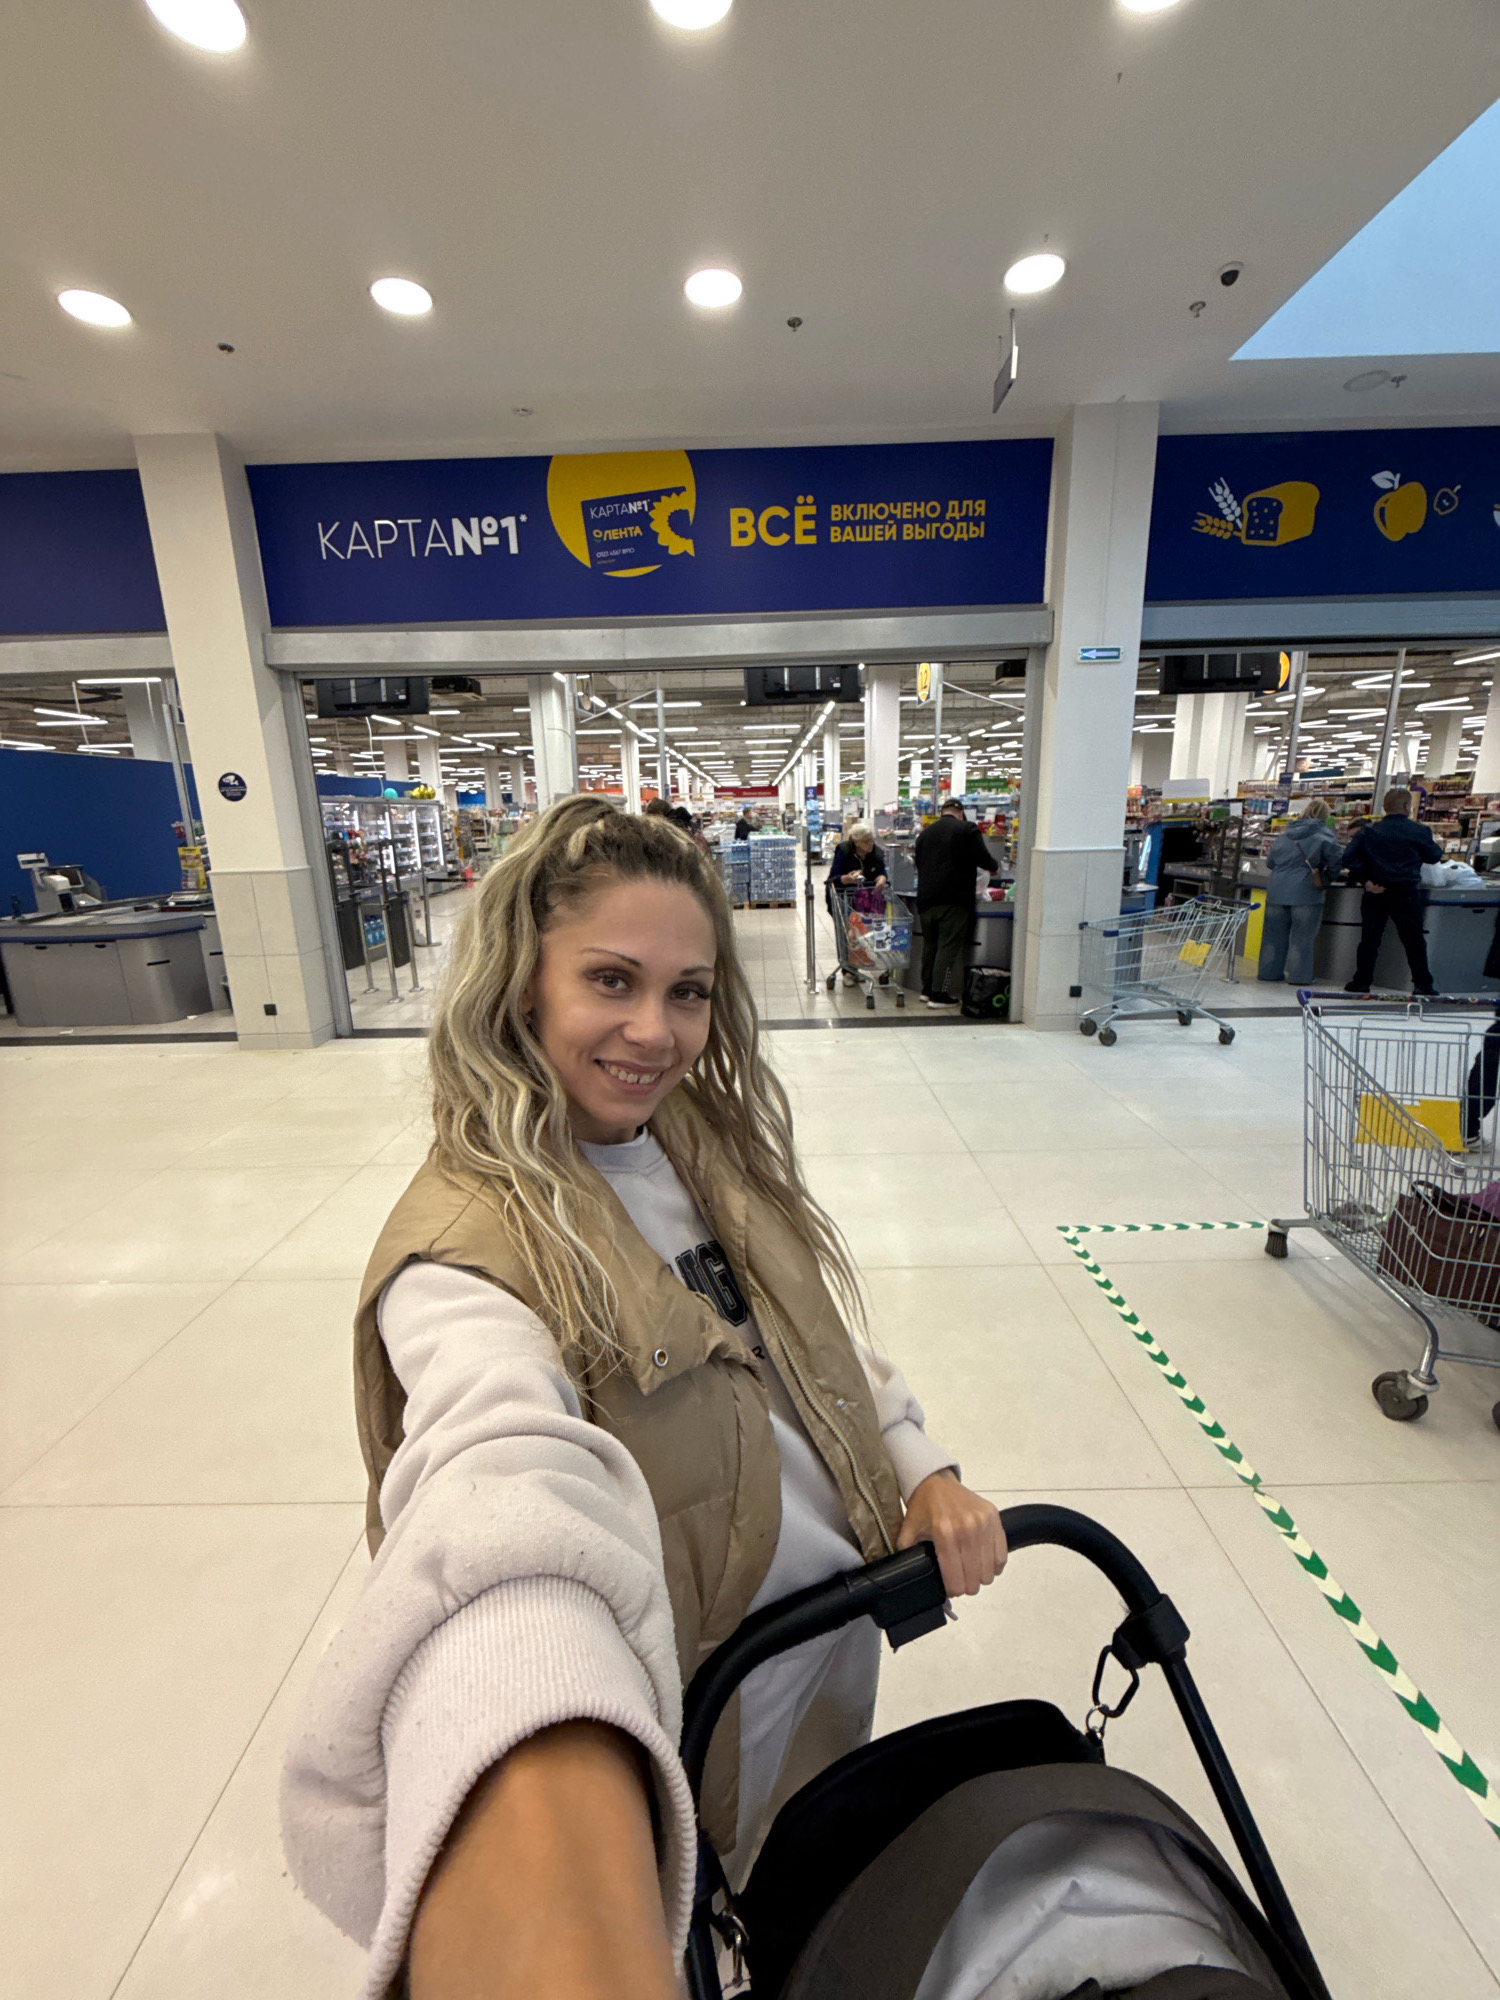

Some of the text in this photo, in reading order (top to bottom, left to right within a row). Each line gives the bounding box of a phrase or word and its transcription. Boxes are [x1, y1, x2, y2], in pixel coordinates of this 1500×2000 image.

[729, 495, 818, 547] ВСЁ
[830, 499, 986, 522] ВКЛЮЧЕНО ДЛЯ
[830, 519, 985, 543] ВАШЕЙ ВЫГОДЫ
